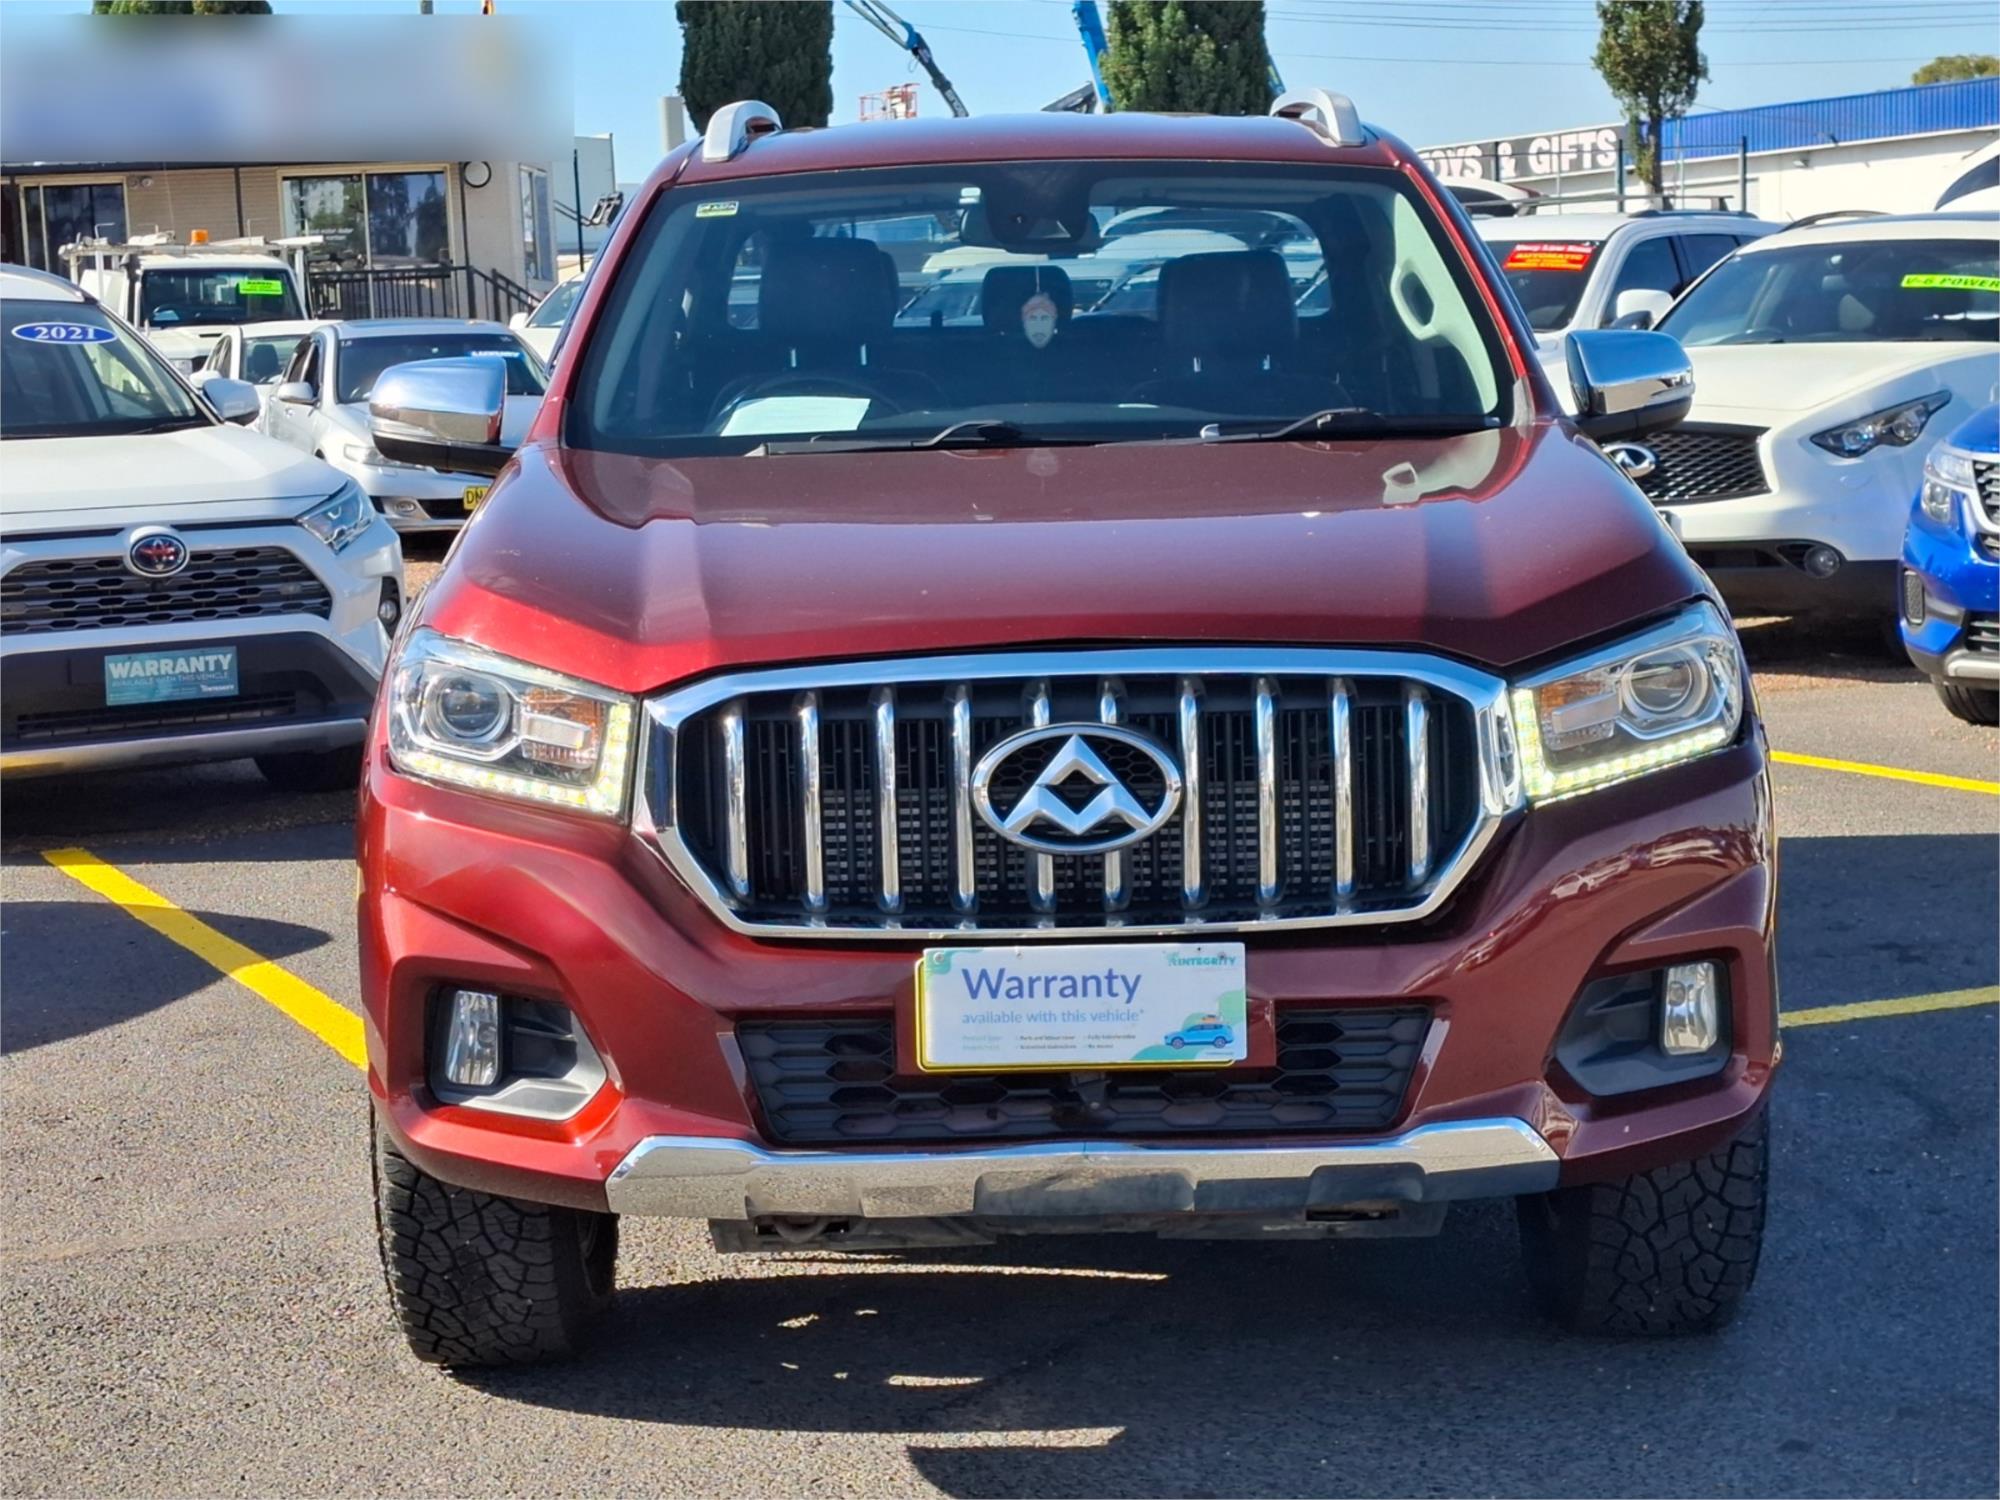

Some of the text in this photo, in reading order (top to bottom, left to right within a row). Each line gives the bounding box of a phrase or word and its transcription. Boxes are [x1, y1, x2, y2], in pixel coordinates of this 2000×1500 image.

[1497, 142, 1517, 178] &
[1528, 129, 1617, 174] GIFTS
[34, 326, 96, 340] 2021
[108, 653, 233, 679] WARRANTY
[1179, 956, 1236, 966] INTEGRITY
[961, 967, 1142, 1004] Warranty
[962, 1011, 1022, 1024] available
[1027, 1011, 1057, 1023] with
[1061, 1010, 1087, 1022] this
